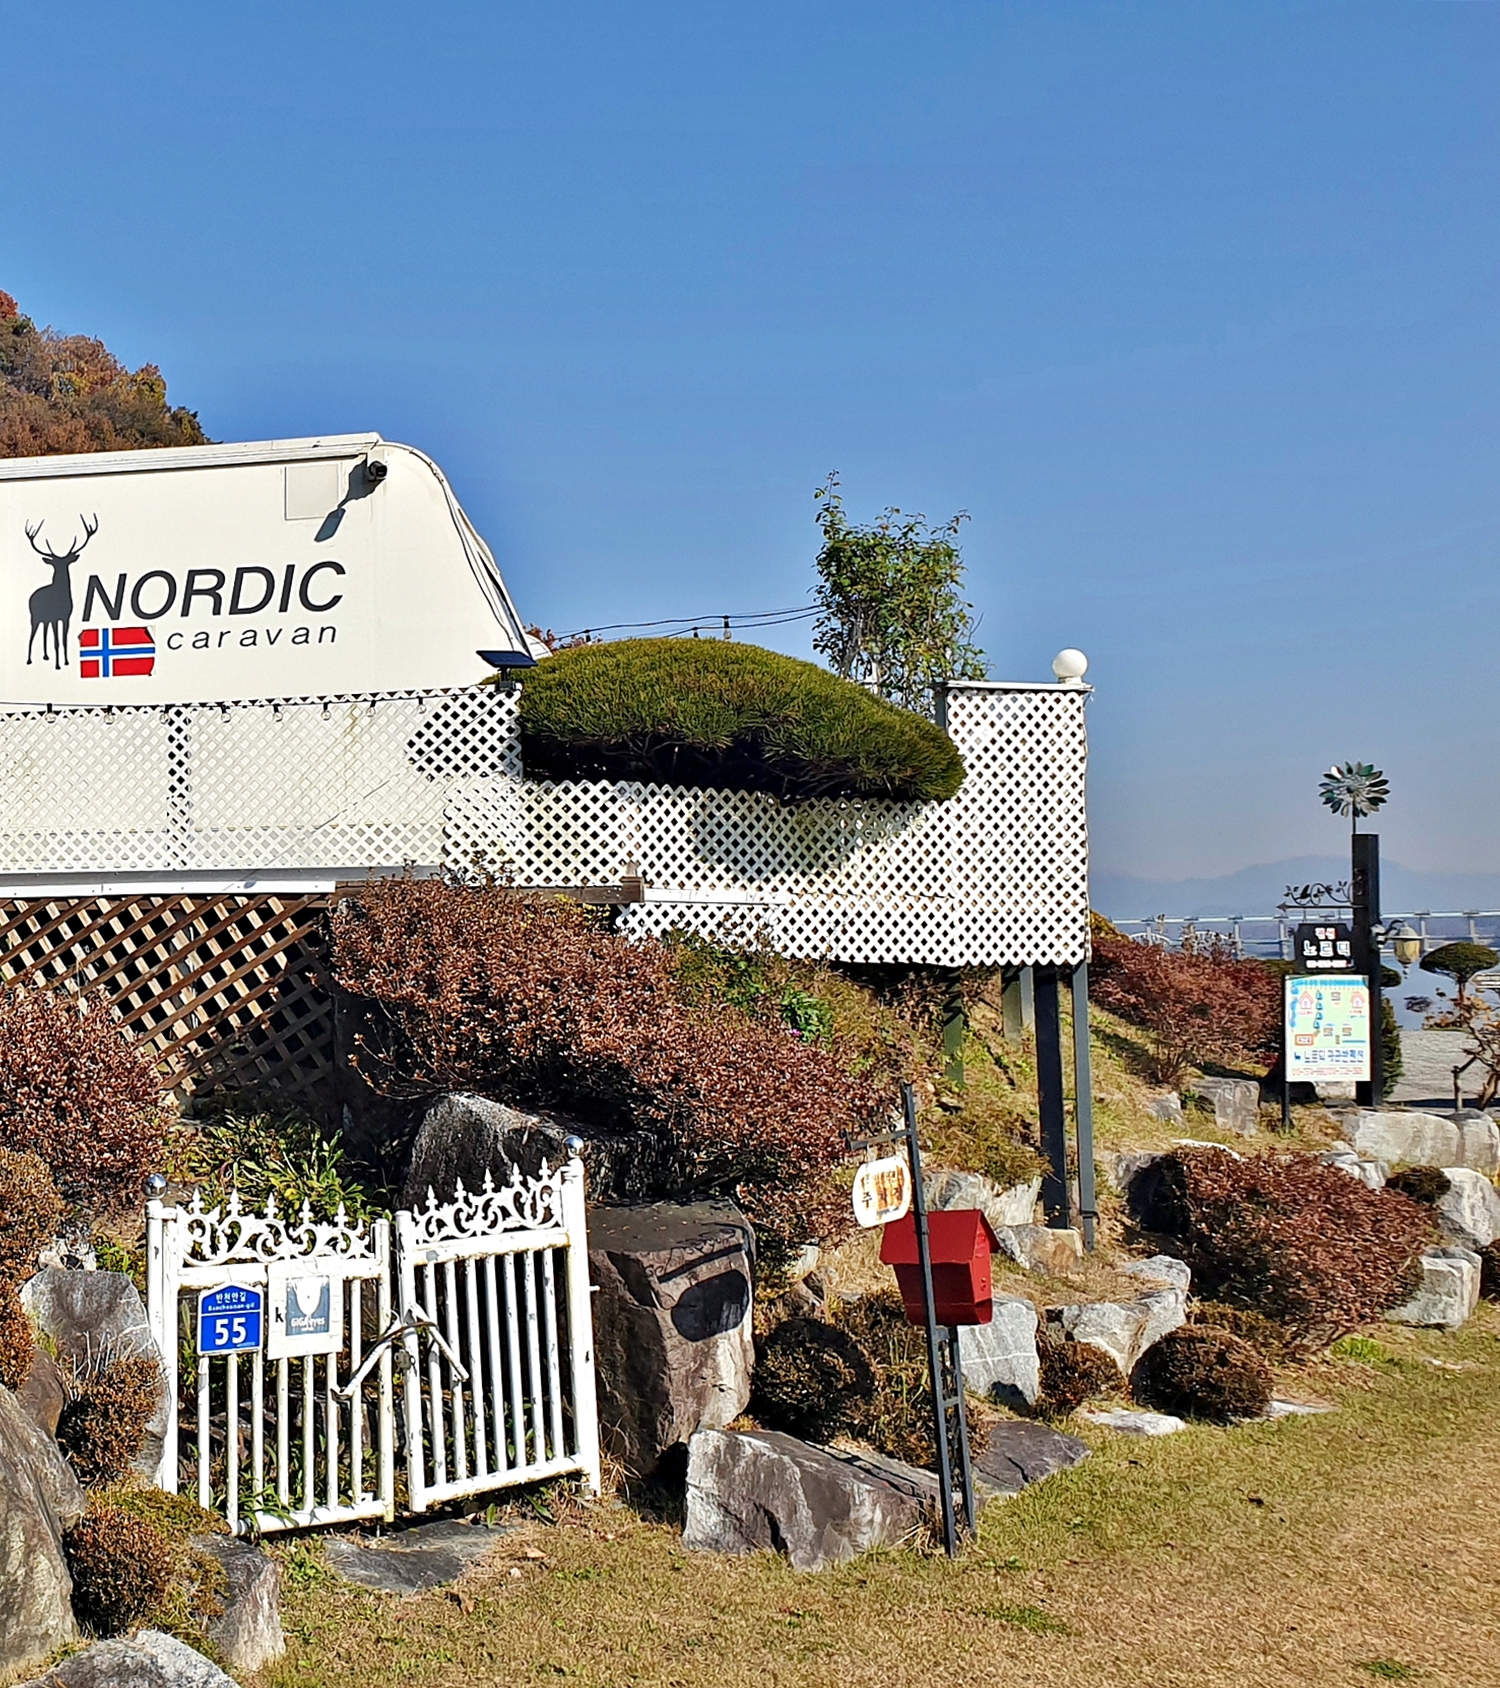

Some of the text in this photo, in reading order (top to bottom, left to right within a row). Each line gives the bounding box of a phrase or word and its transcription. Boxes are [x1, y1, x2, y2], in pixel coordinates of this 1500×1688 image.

[82, 561, 347, 622] NORDIC
[166, 625, 337, 651] caravan
[1303, 939, 1352, 958] 노르딕
[215, 1317, 247, 1346] 55
